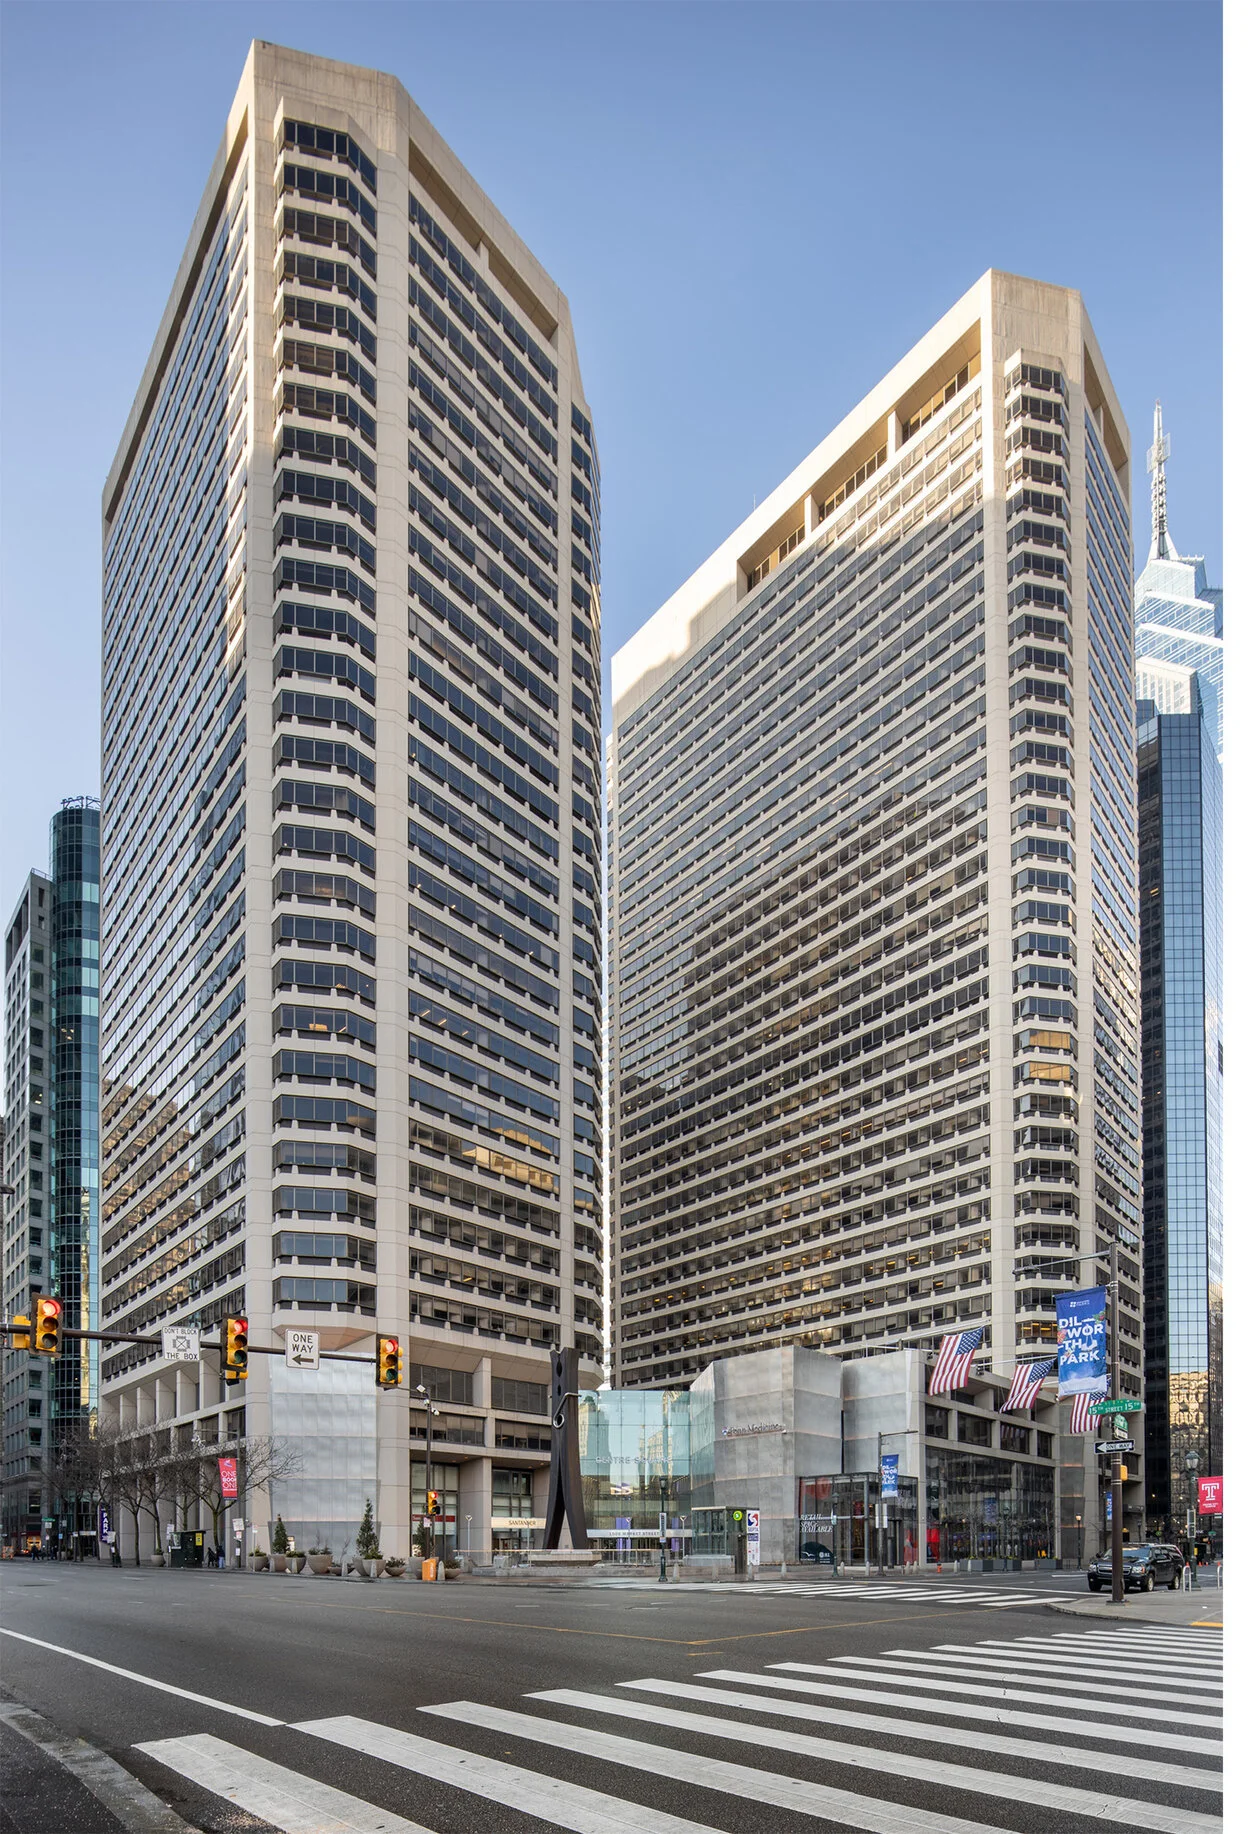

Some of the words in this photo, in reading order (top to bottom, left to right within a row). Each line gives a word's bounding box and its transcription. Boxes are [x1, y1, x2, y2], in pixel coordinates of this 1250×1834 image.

[1068, 1324, 1104, 1338] WOR
[292, 1333, 313, 1344] ONE
[292, 1344, 314, 1353] WAY
[166, 1352, 180, 1360] THE
[1060, 1350, 1100, 1366] PARK
[595, 1456, 630, 1464] CENTRE
